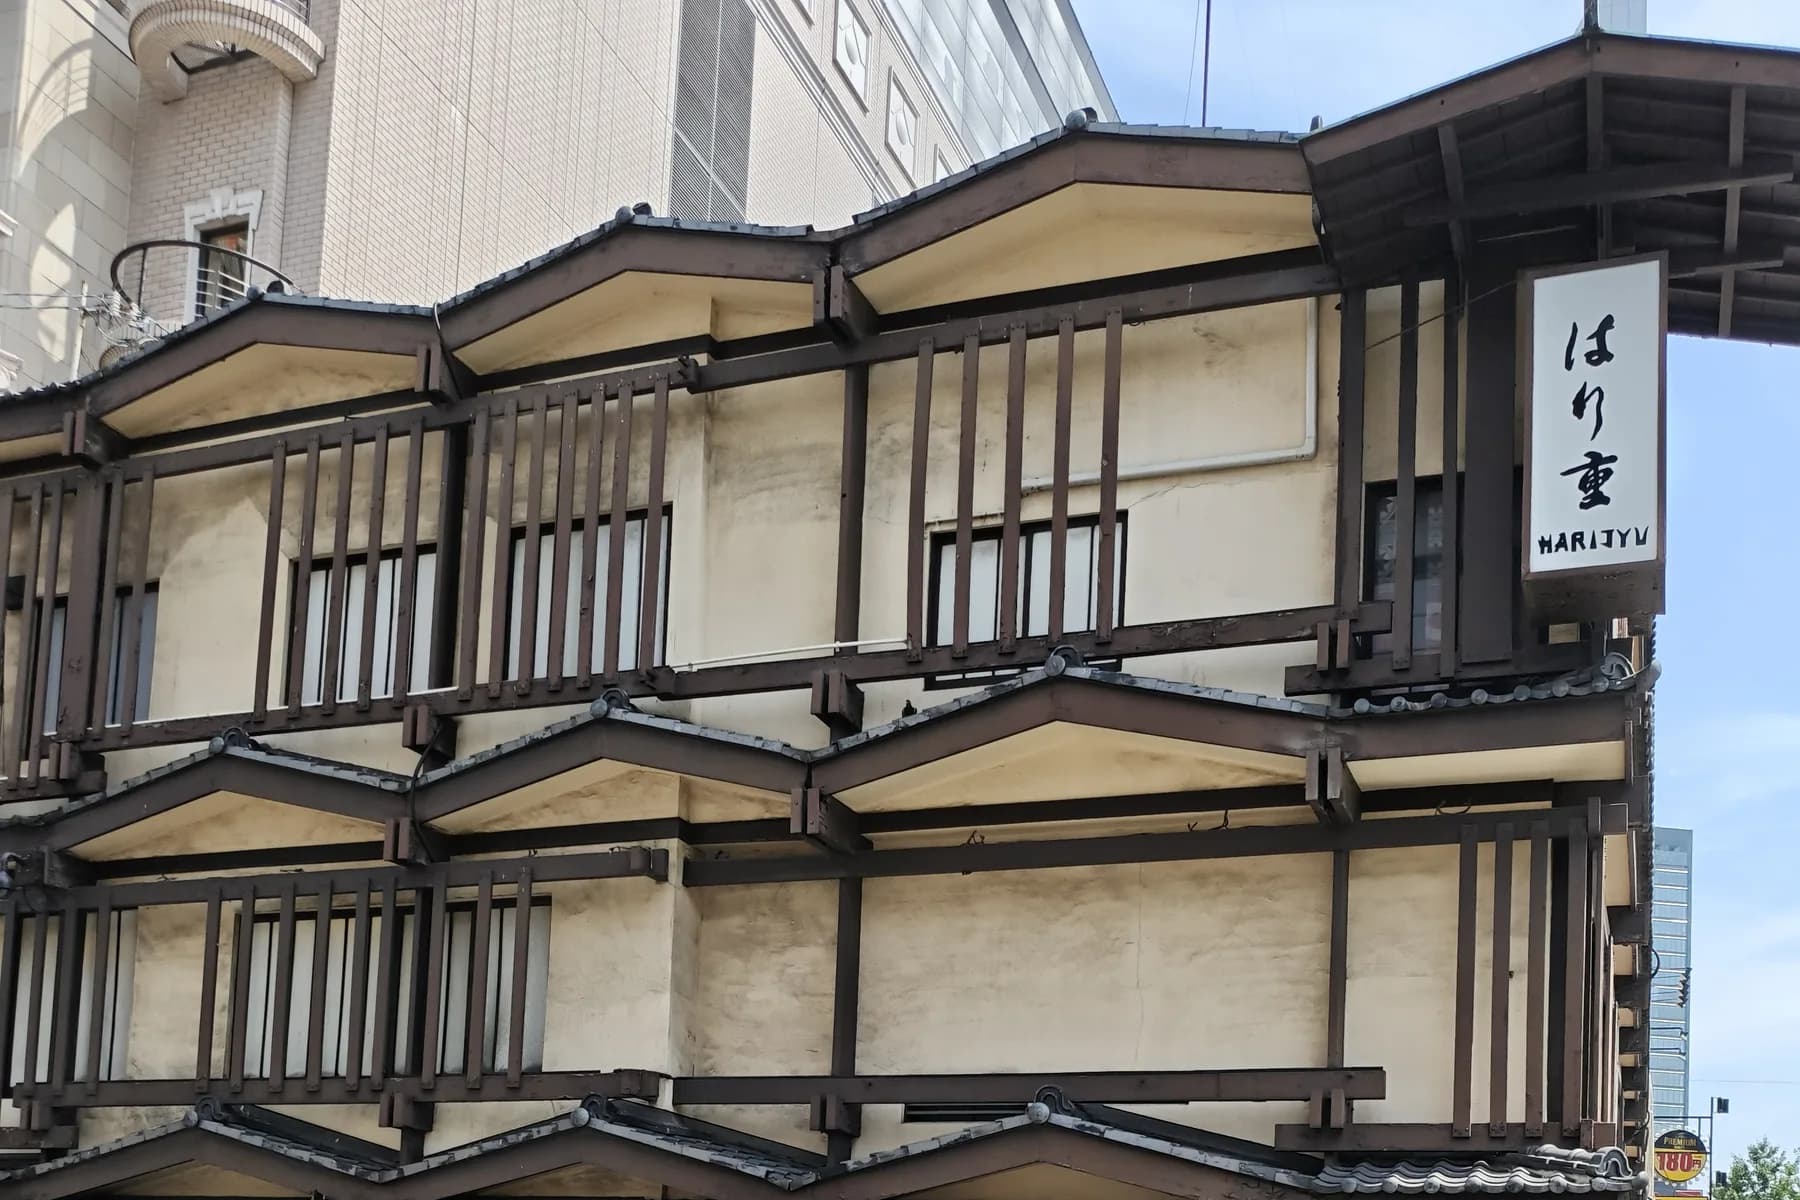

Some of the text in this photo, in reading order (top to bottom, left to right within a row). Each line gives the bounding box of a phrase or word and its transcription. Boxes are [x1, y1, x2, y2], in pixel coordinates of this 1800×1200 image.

[1560, 313, 1618, 510] はり重
[1537, 525, 1650, 555] HARIJYU
[1663, 1136, 1697, 1147] PREMIUM
